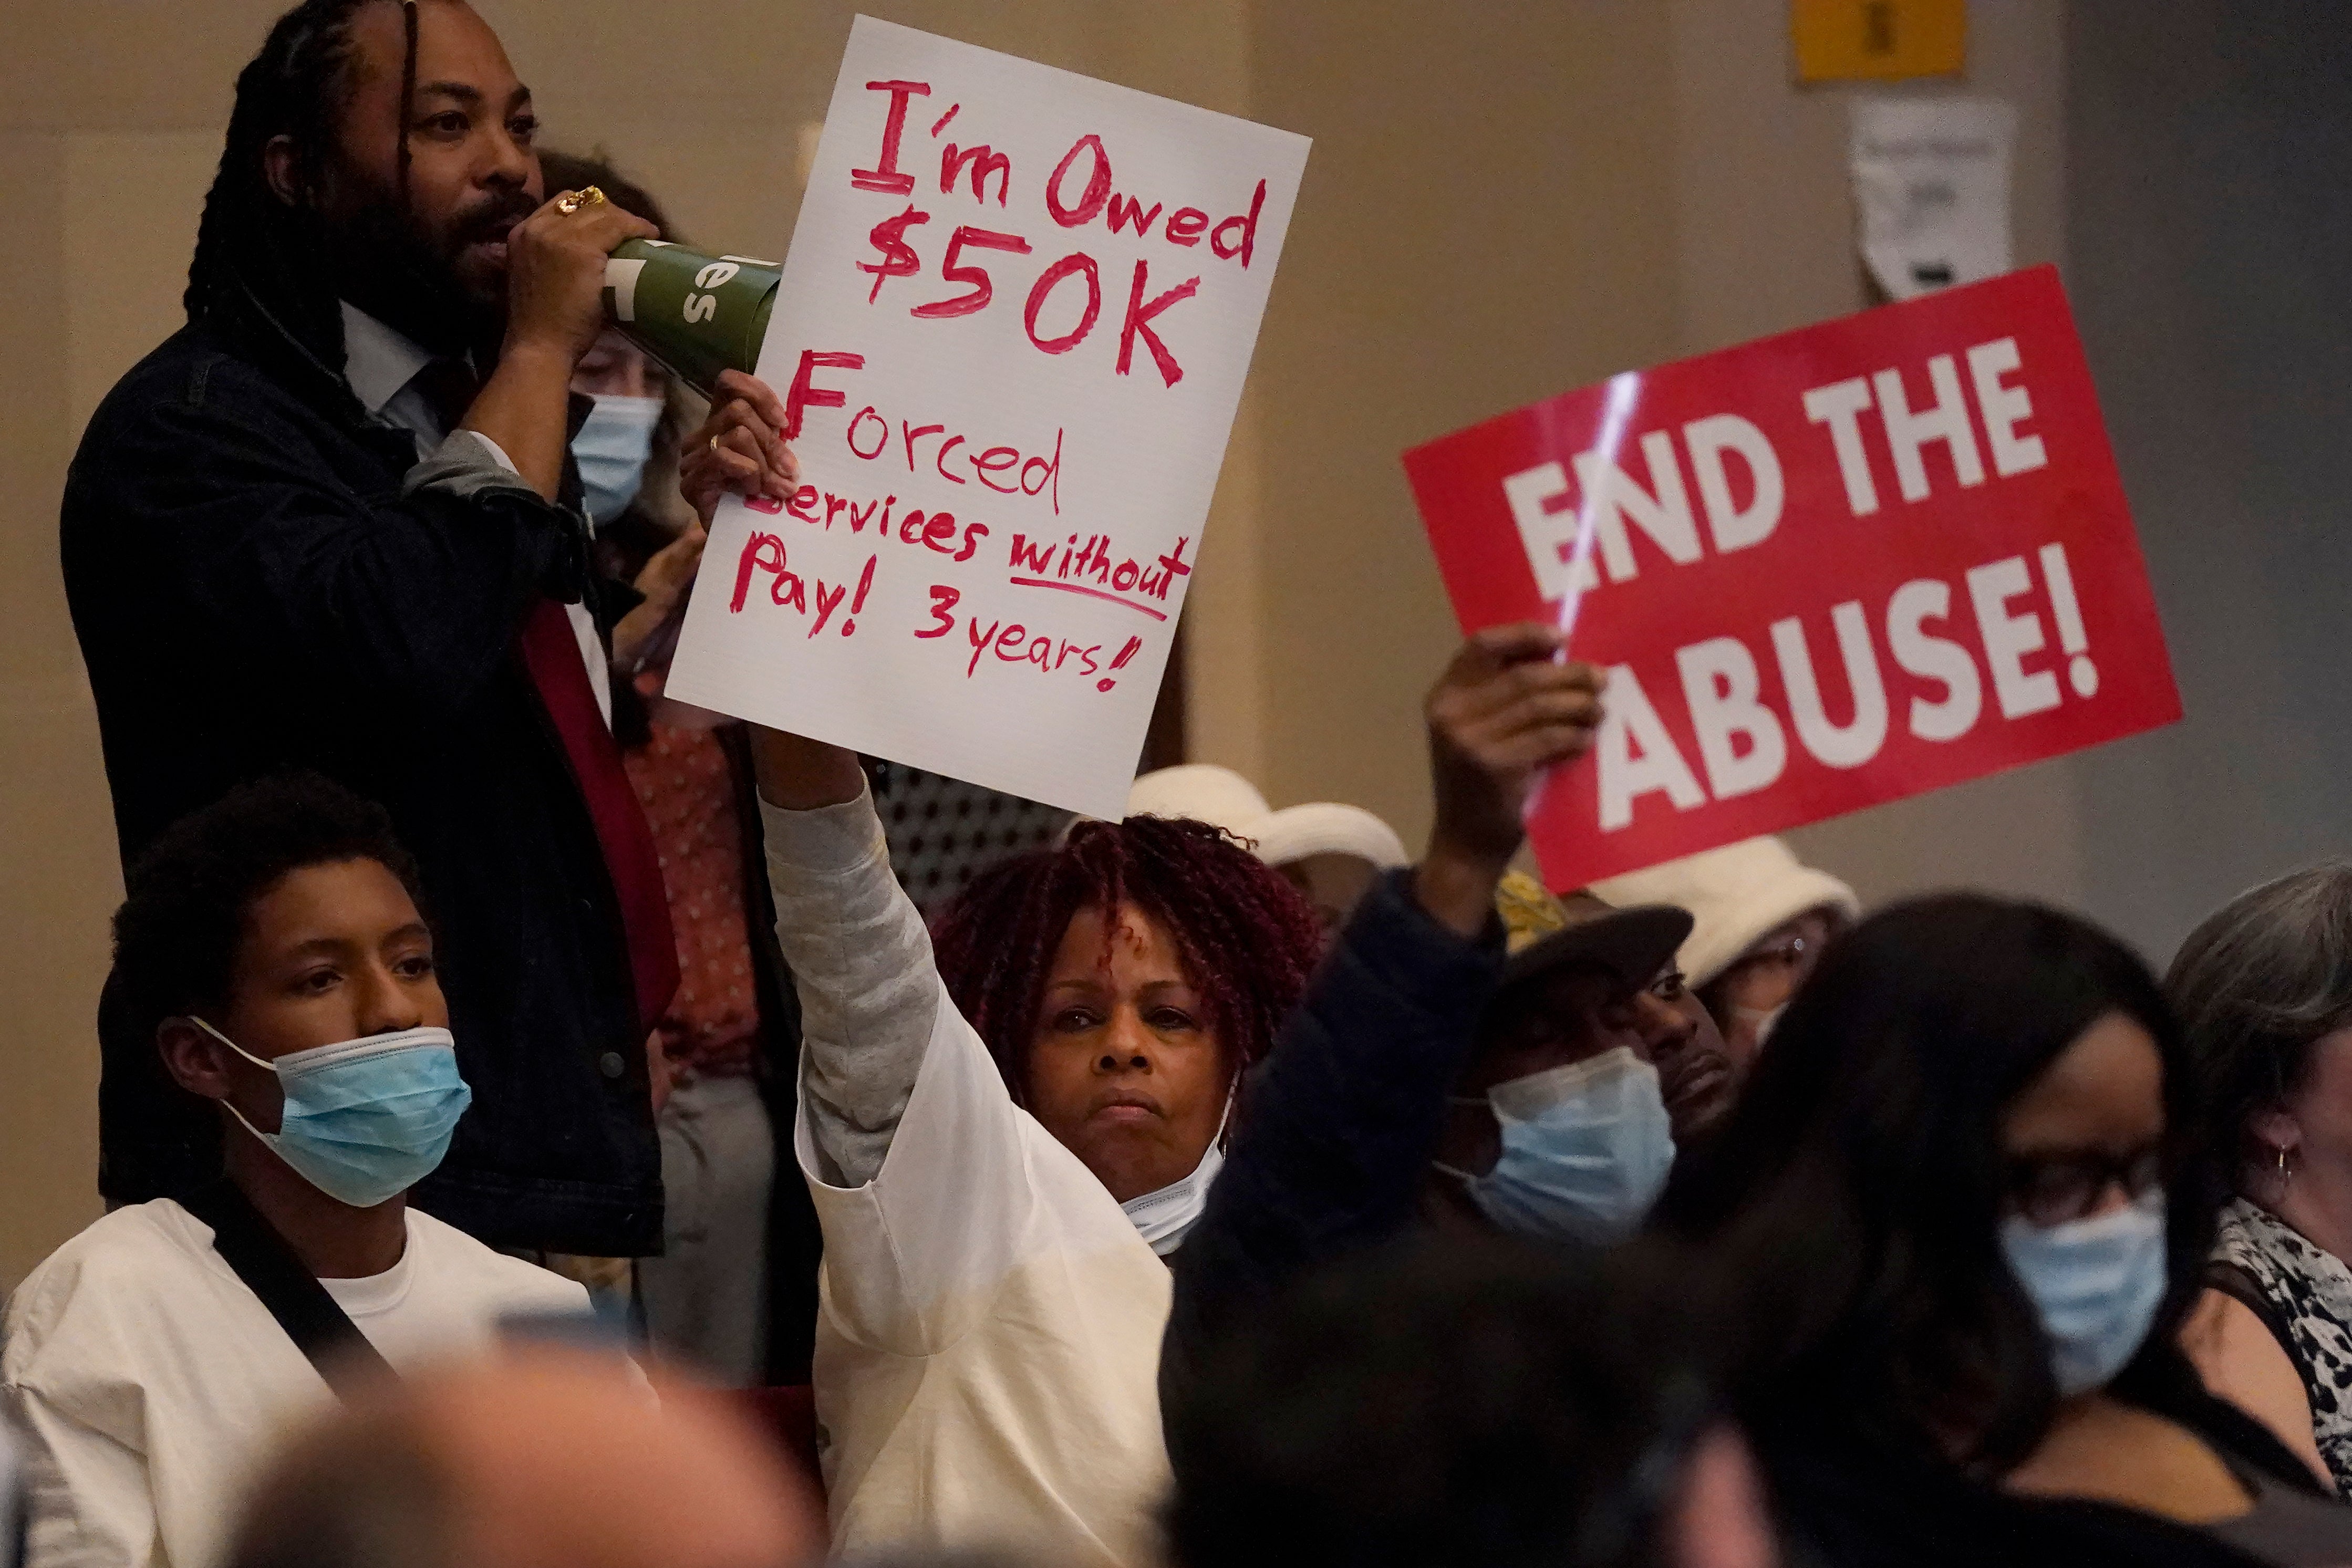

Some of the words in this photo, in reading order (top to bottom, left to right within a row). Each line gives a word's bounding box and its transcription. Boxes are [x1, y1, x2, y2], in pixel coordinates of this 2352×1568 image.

[851, 79, 1011, 208] I'm
[1045, 134, 1267, 269] Owed
[855, 204, 1200, 389] $50K
[781, 350, 1063, 515] Forced
[1503, 412, 1785, 603] END
[1803, 336, 2047, 516] THE
[729, 531, 877, 639] Pay!
[744, 490, 989, 563] ervices
[1009, 534, 1190, 600] without
[1597, 543, 2098, 832] ABUSE!
